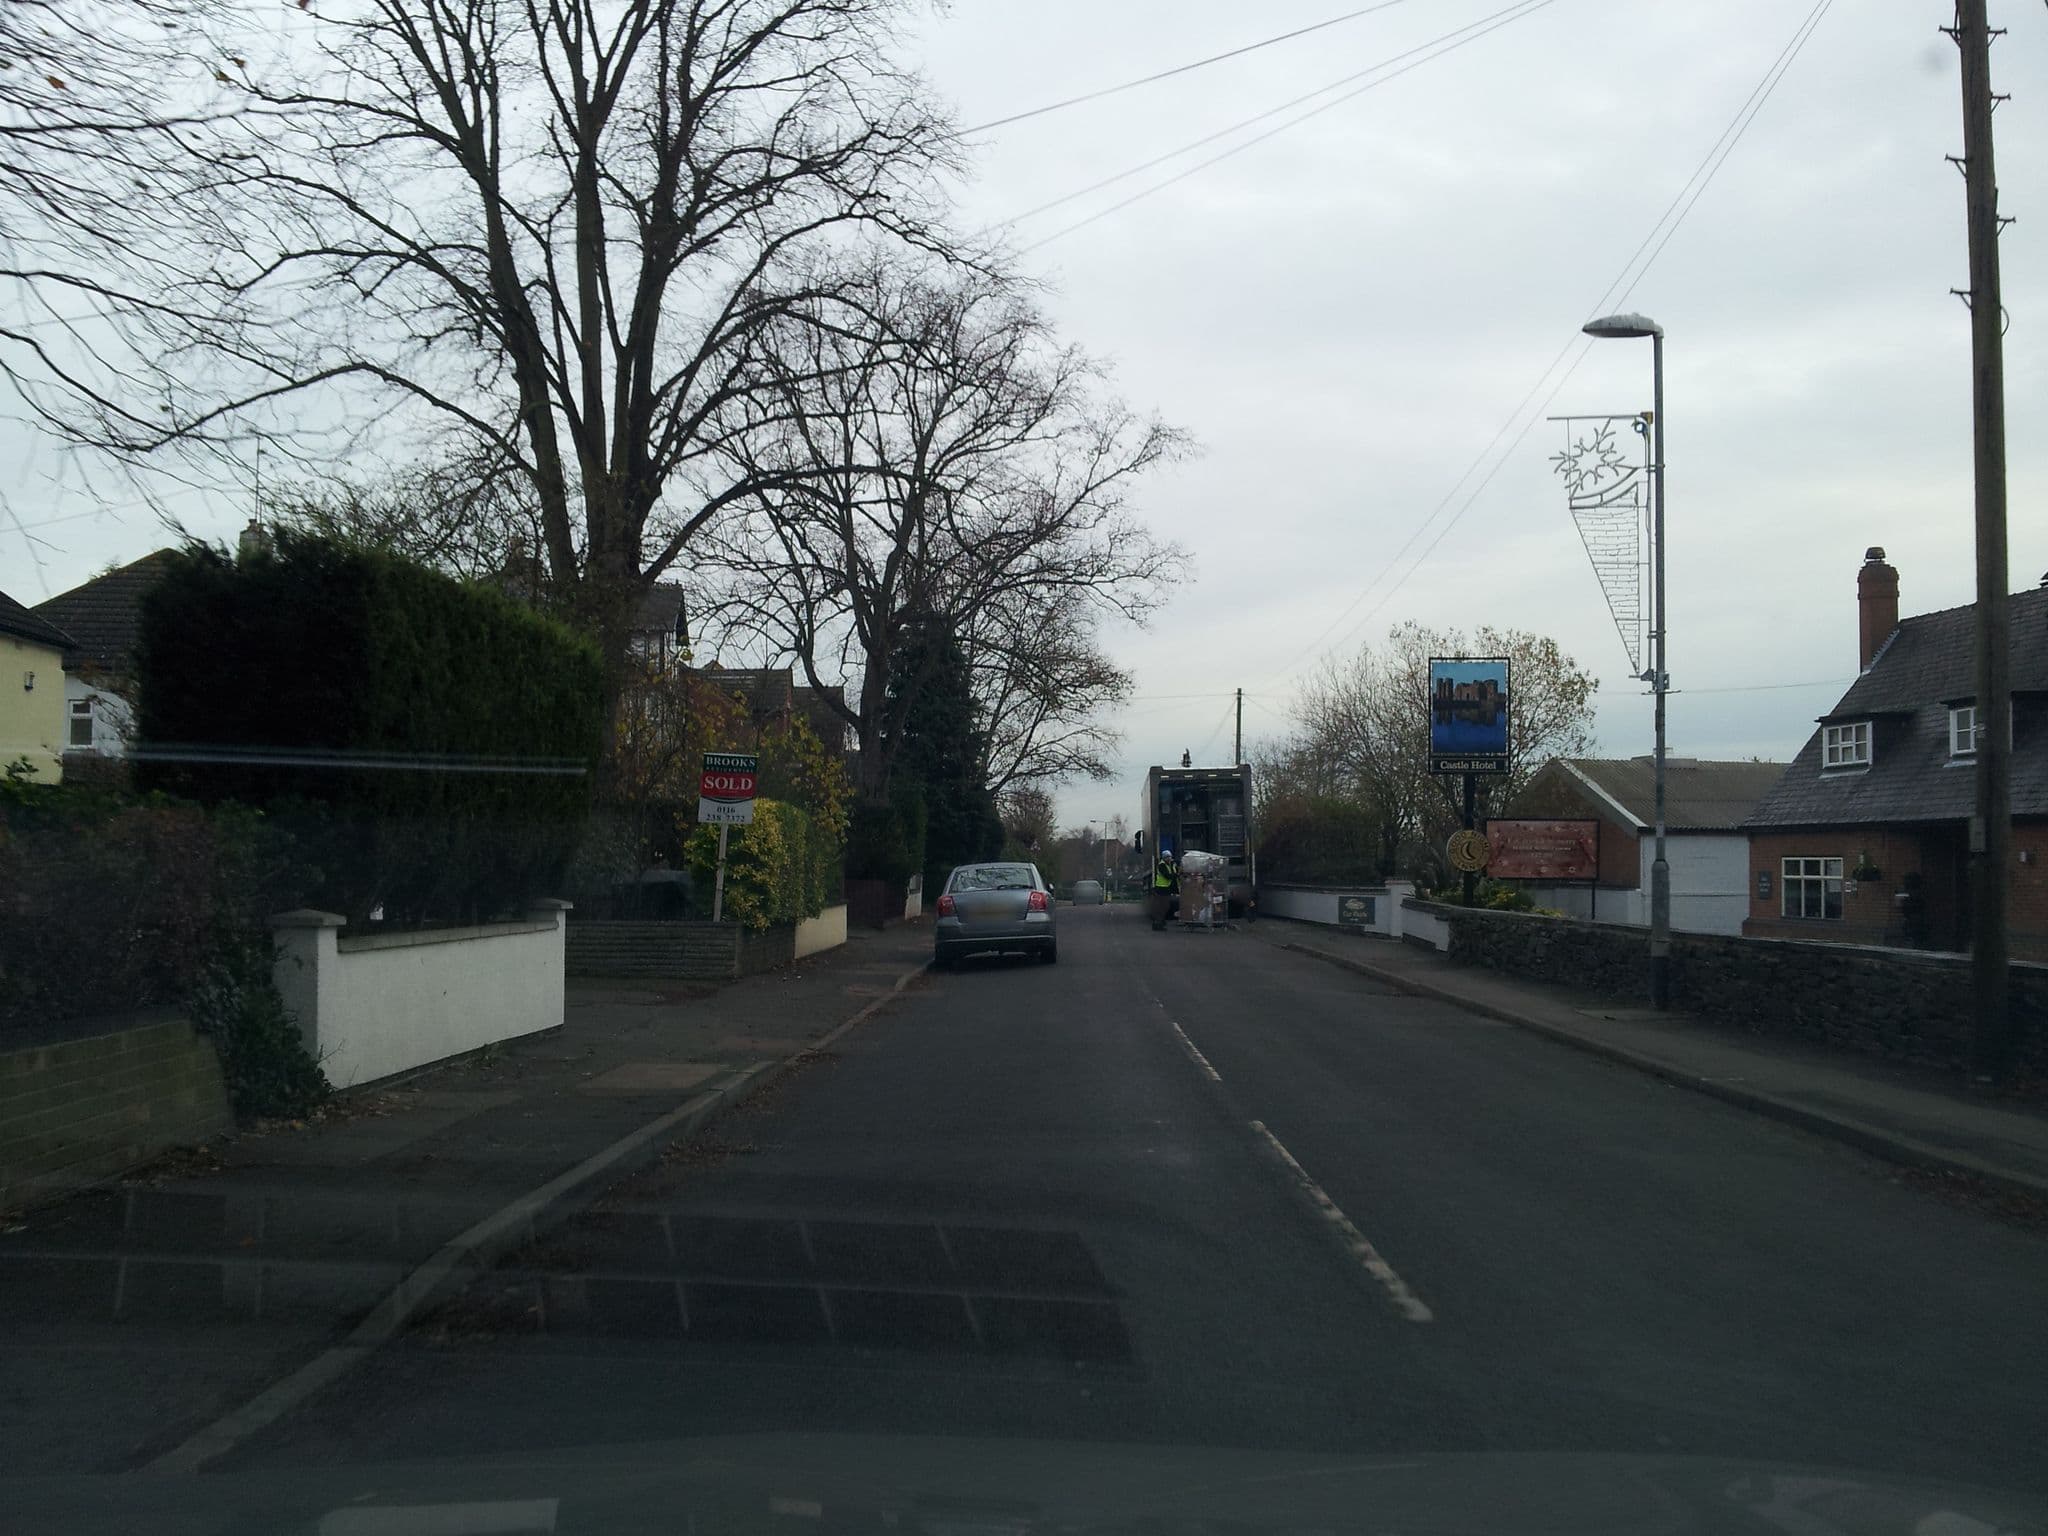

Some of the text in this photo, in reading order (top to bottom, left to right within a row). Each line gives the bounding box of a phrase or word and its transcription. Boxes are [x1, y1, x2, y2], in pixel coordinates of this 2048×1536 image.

[706, 756, 756, 766] BROOKS
[1440, 760, 1496, 770] Castle Hotel
[704, 775, 753, 790] SOLD
